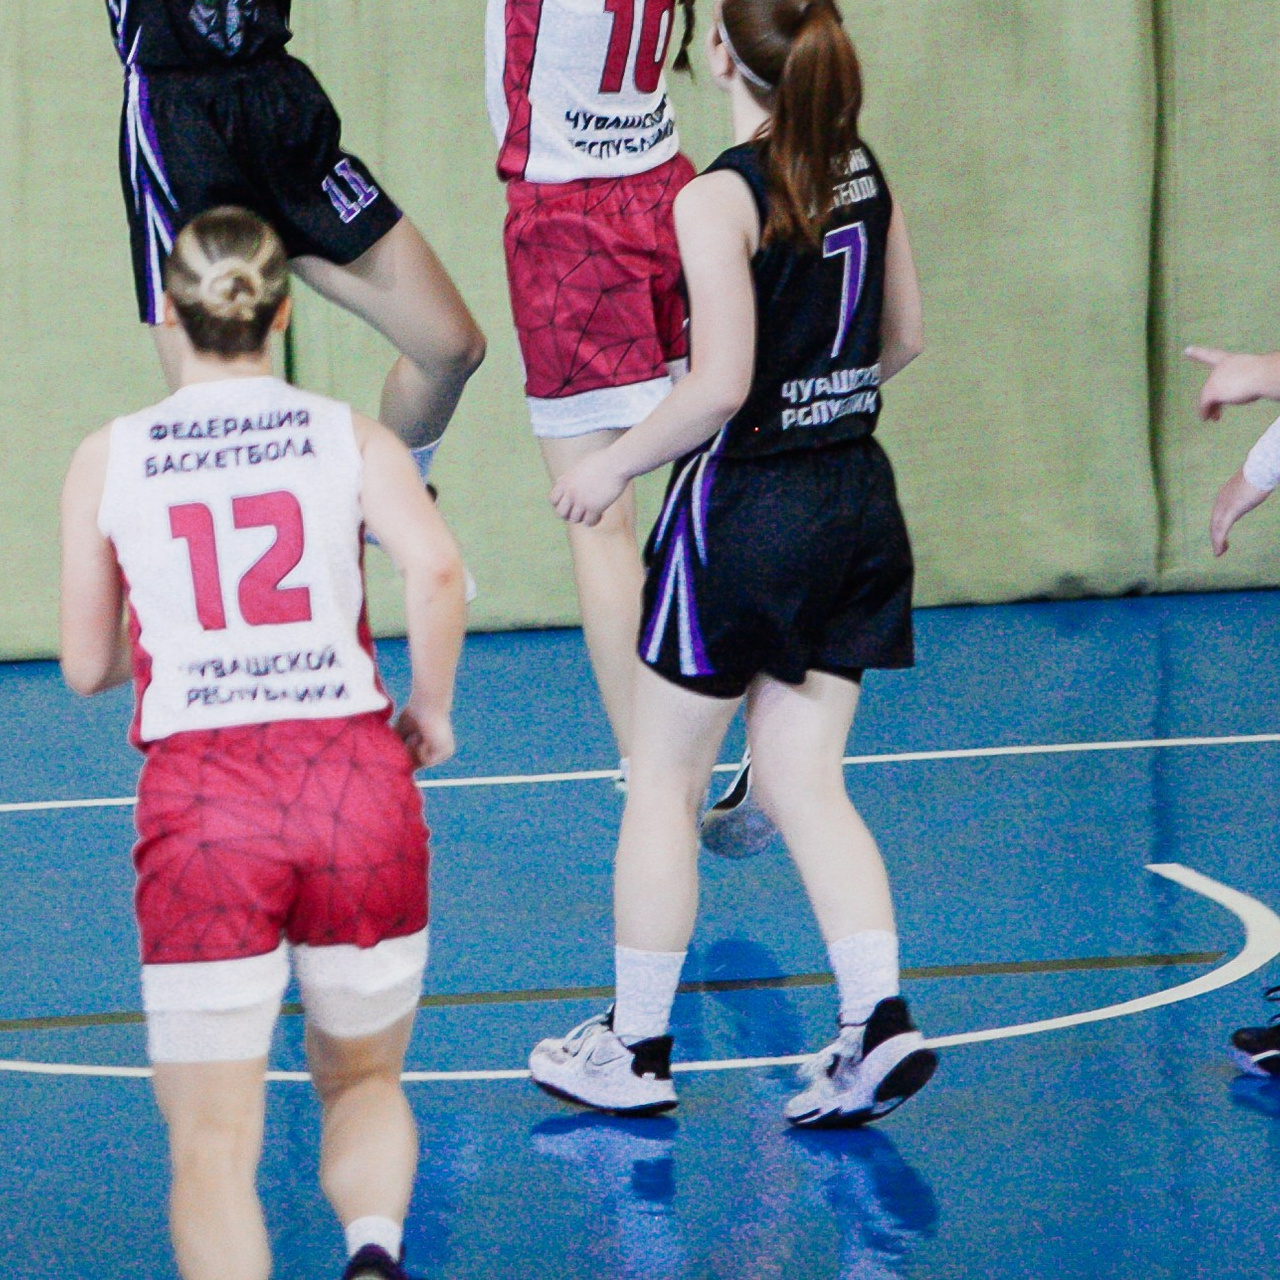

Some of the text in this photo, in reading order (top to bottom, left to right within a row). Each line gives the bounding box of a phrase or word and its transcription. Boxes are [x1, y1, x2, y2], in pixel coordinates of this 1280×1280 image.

[321, 158, 379, 224] 11
[822, 220, 869, 359] 7
[144, 437, 316, 478] БАСКЕТБОЛА
[150, 409, 310, 441] ФЕДЕРАЦИЯ
[169, 490, 312, 631] 12
